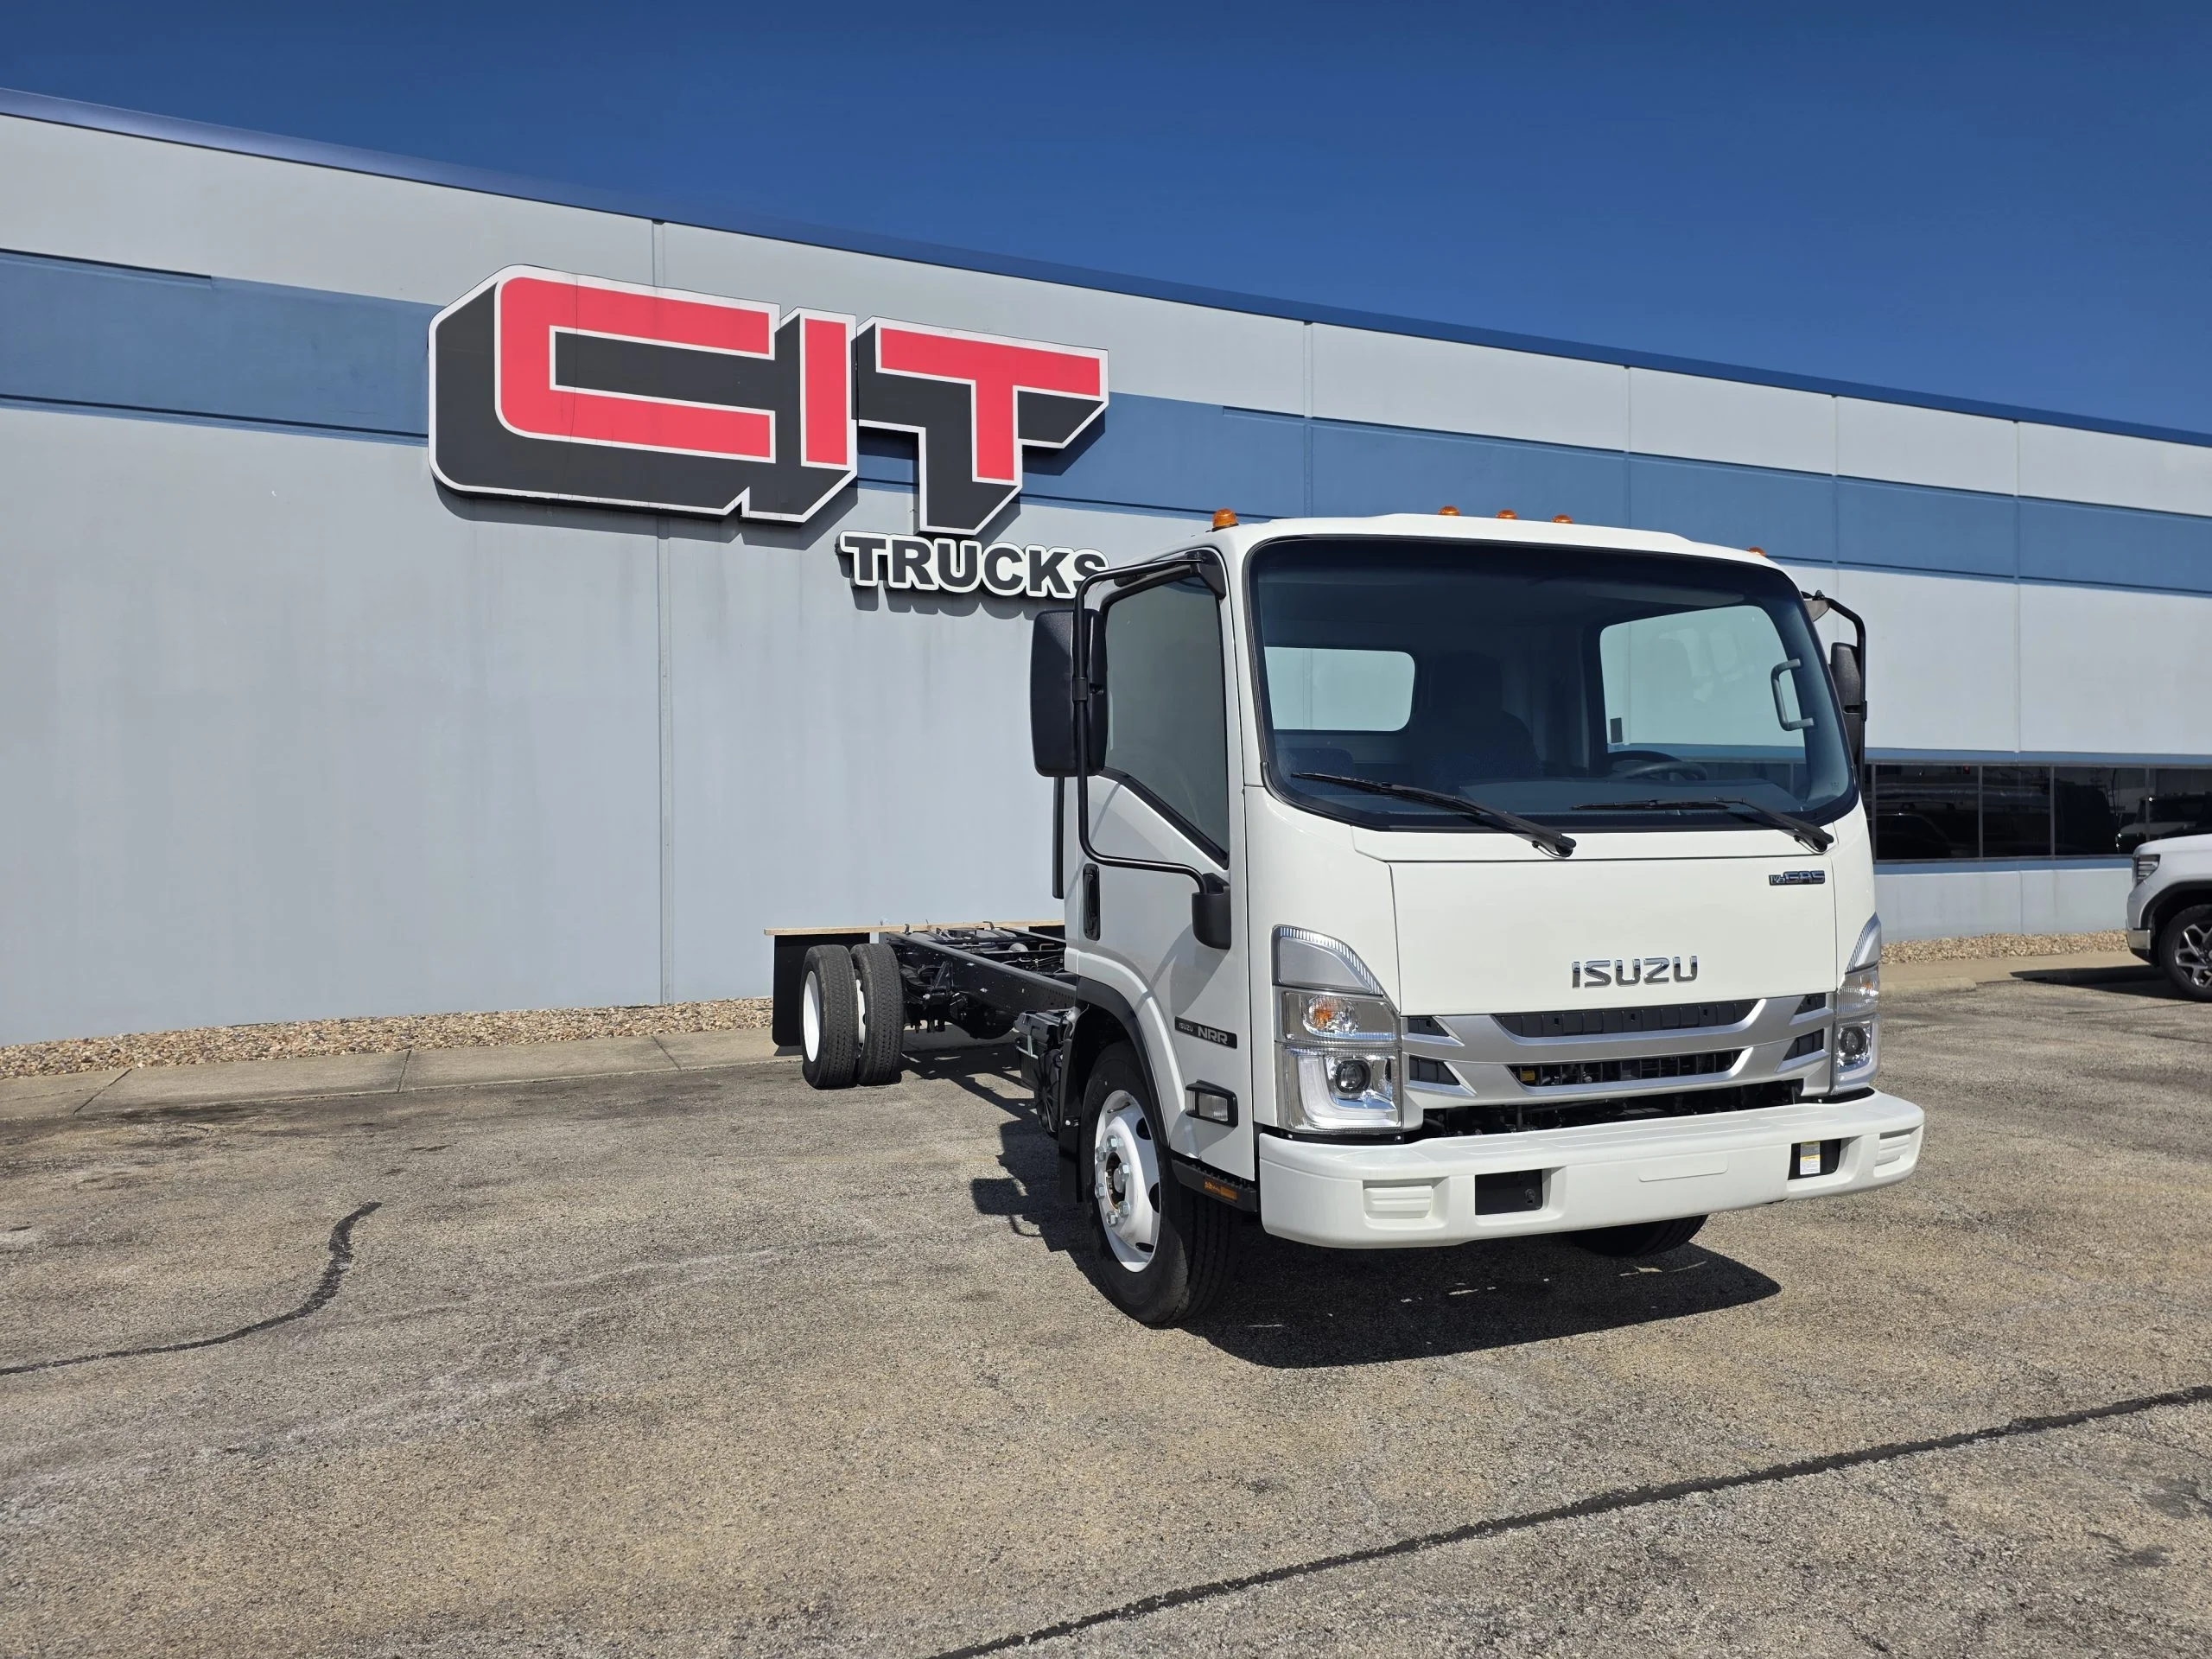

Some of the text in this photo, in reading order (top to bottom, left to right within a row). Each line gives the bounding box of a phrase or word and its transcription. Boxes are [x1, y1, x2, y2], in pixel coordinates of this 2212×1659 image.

[489, 270, 1106, 491] CIT
[843, 533, 1109, 594] TRUCKS
[1572, 955, 1698, 988] ISUZU
[1179, 1022, 1228, 1045] ISUZU NRR
